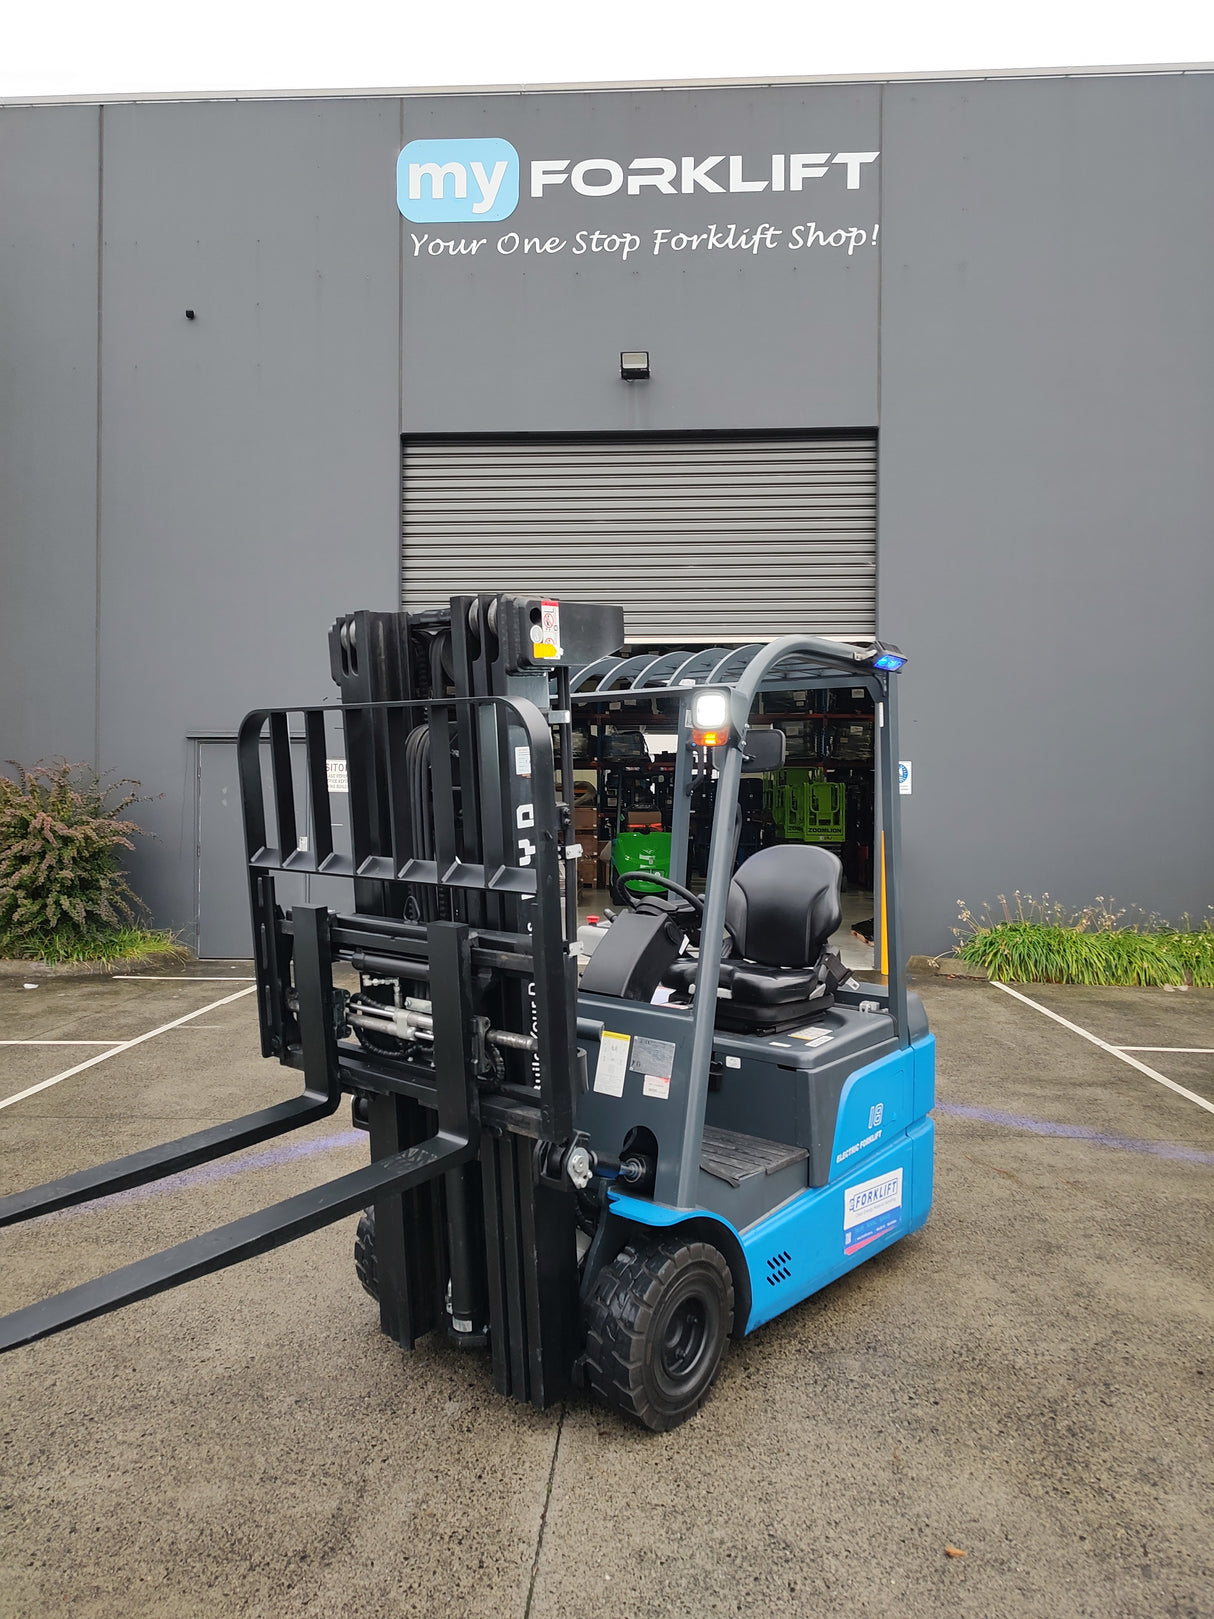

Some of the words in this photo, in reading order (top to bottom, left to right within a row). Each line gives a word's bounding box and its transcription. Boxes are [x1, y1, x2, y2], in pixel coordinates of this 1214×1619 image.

[408, 160, 508, 214] my
[530, 151, 880, 198] FORKLIFT
[411, 232, 487, 257] Your
[496, 231, 567, 256] One
[572, 230, 641, 260] Stop
[653, 223, 784, 255] Forklift
[793, 221, 880, 255] Shop!
[859, 1129, 882, 1150] FORKLIFT
[855, 1181, 898, 1209] FORKLIFT
